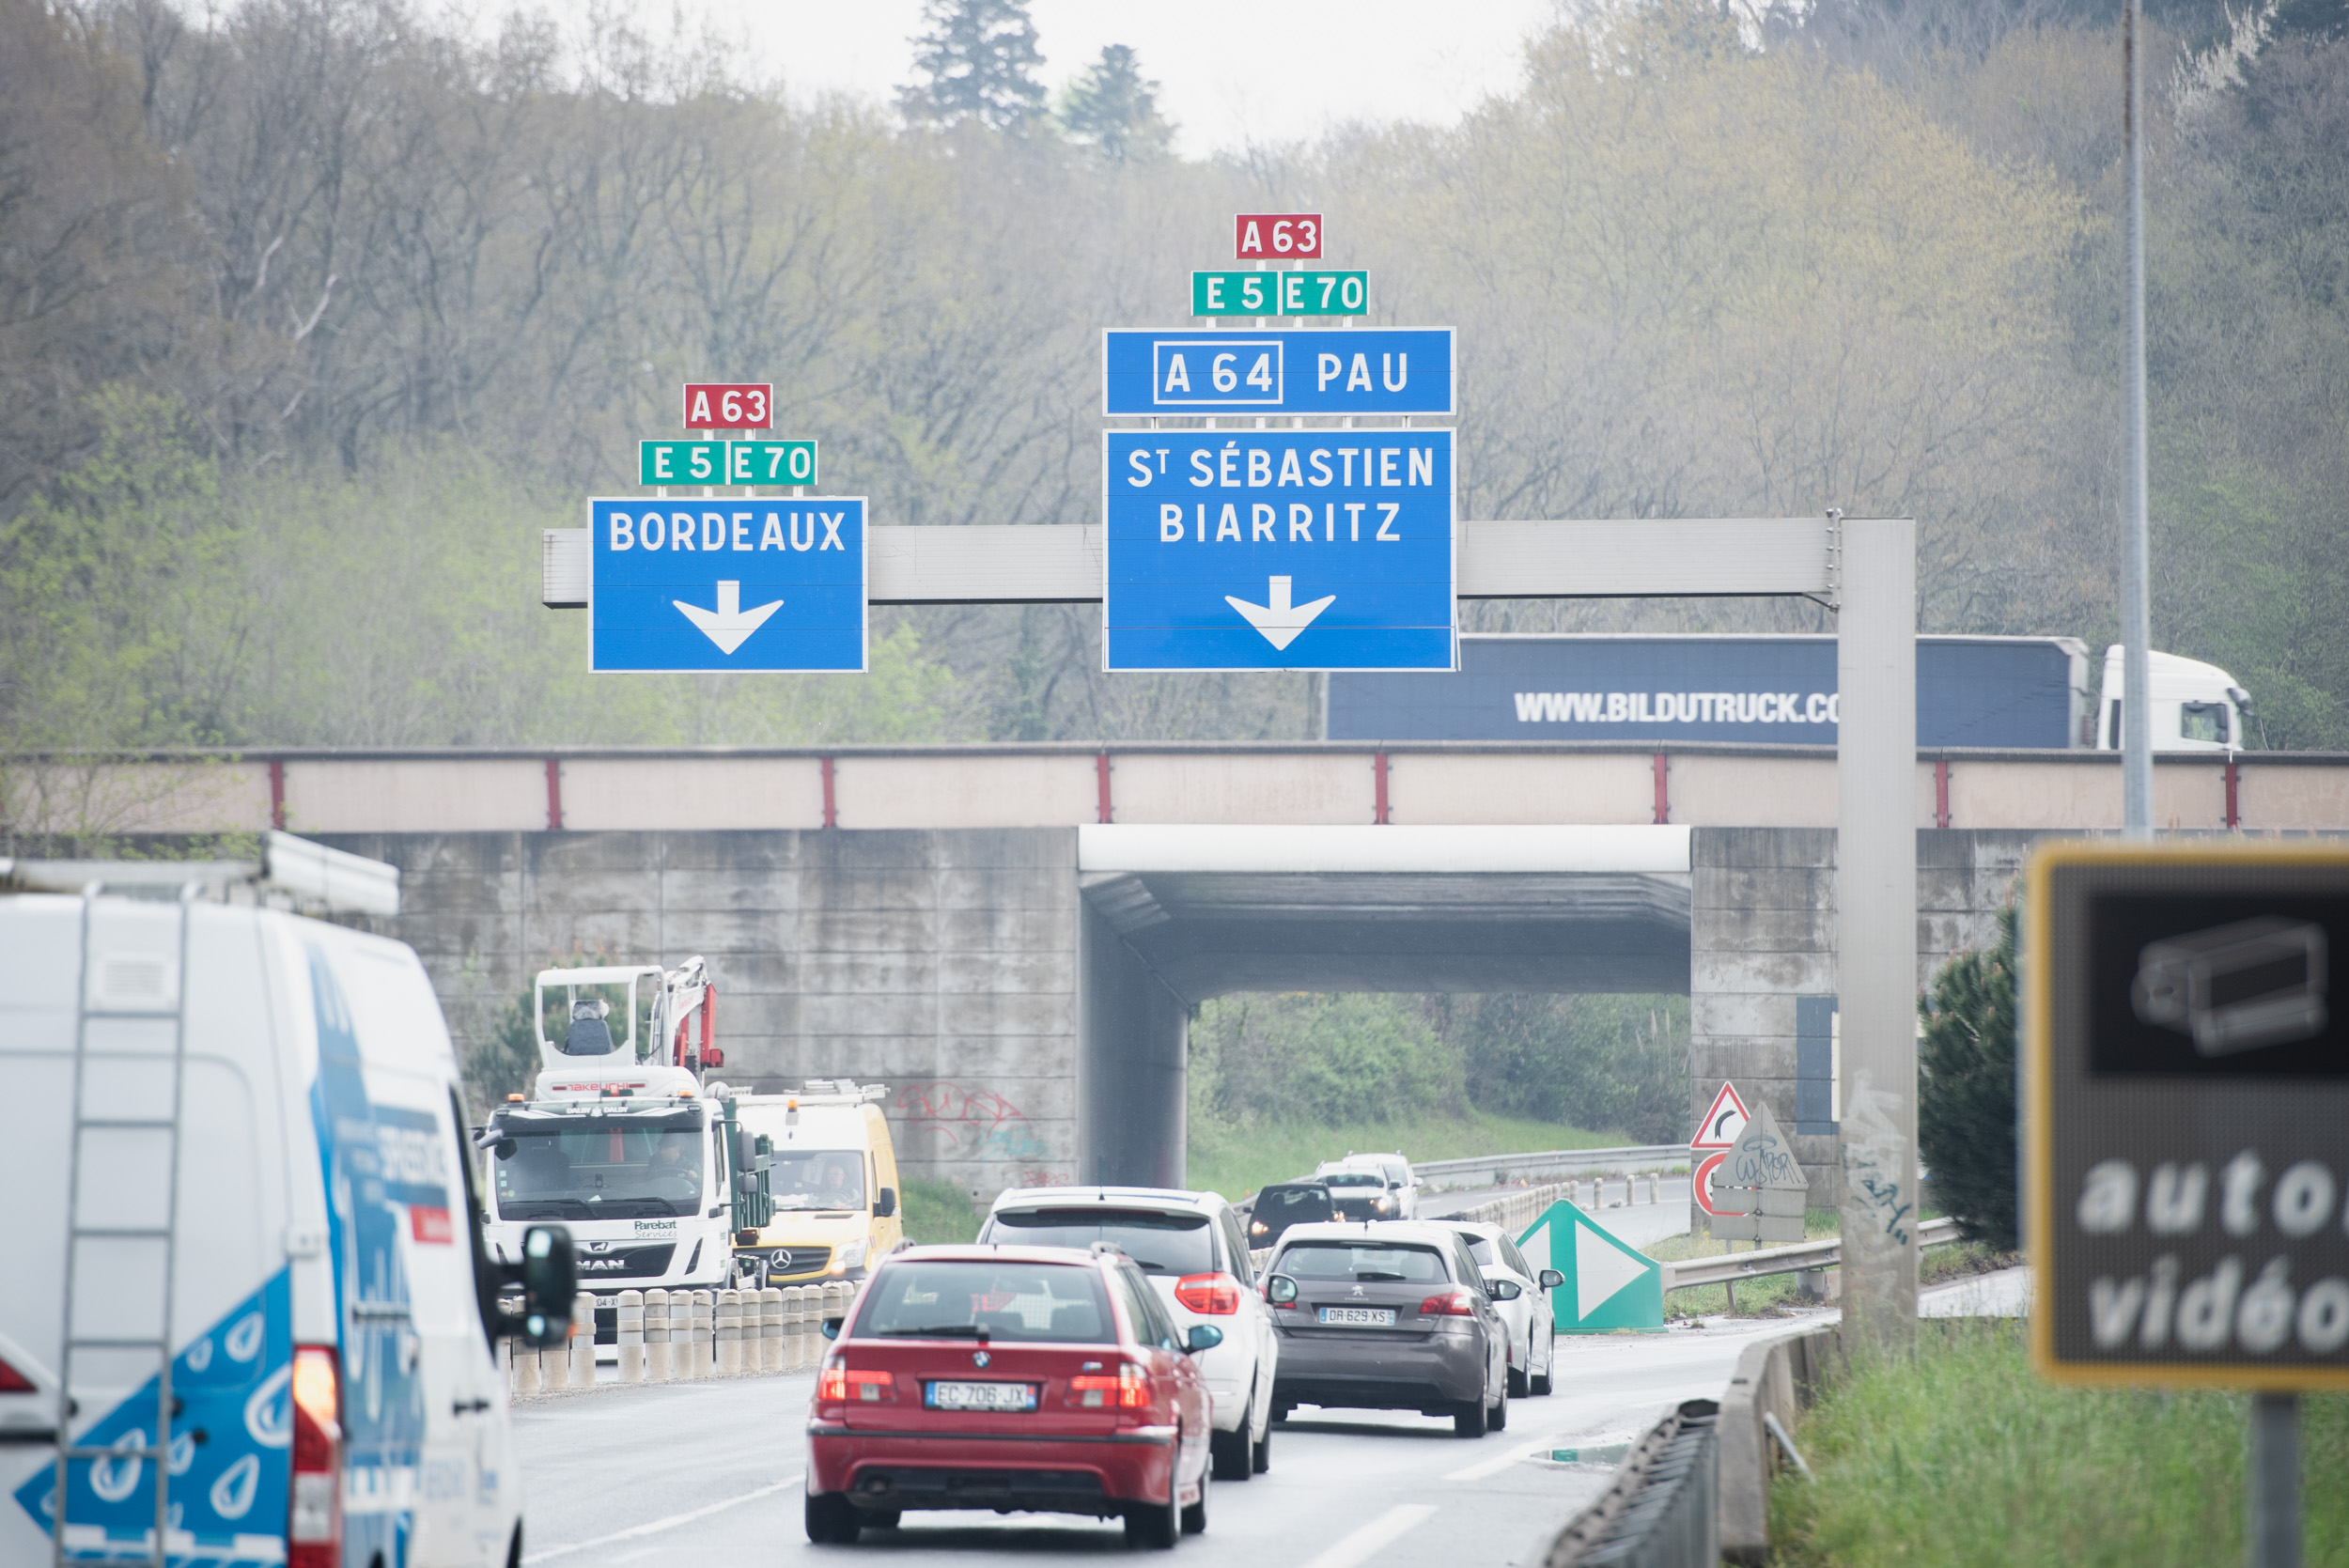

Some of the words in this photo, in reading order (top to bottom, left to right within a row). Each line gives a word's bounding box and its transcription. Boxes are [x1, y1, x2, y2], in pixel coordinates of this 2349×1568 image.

[1241, 221, 1262, 253] A
[1272, 220, 1316, 253] 63
[1207, 277, 1225, 309] E
[1241, 277, 1264, 309] 5
[1286, 277, 1304, 309] E
[1316, 276, 1363, 309] 70
[1165, 353, 1190, 393] A
[1212, 352, 1272, 393] 64
[1317, 352, 1408, 393] PAU
[691, 391, 712, 422] A
[722, 391, 766, 423] 63
[655, 447, 674, 478] E
[690, 447, 712, 478] 5
[735, 447, 753, 478] E
[765, 446, 811, 479] 70
[1189, 441, 1433, 488] SÉBASTIEN
[610, 512, 846, 551] BORDEAUX
[1160, 503, 1400, 542] BIARRITZ
[2075, 1148, 2349, 1240] auto
[634, 1220, 677, 1230] Parebat
[635, 1230, 677, 1238] Services
[576, 1259, 625, 1270] MAN
[1330, 1310, 1385, 1323] DR-629-XS
